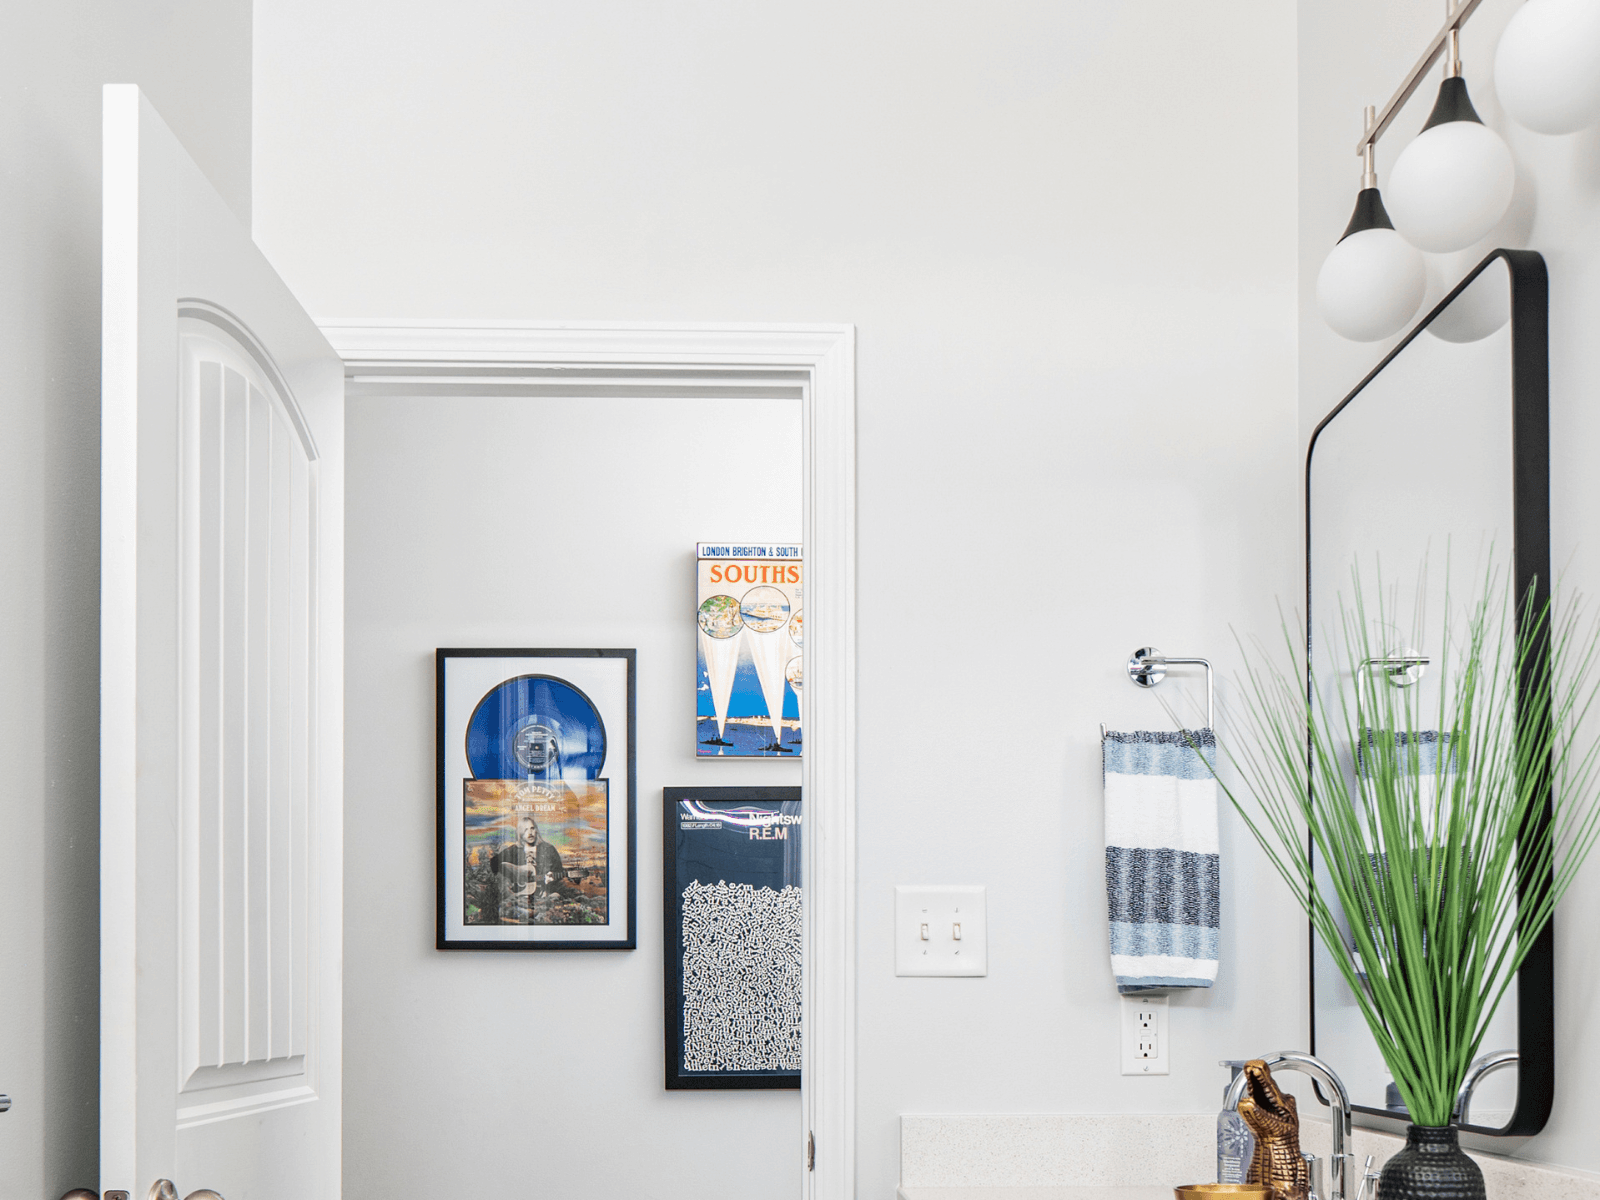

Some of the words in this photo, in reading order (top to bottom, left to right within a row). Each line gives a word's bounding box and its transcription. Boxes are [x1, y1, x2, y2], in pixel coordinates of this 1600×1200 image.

[702, 546, 730, 556] LONDON
[732, 546, 766, 556] BRIGHTON
[768, 546, 774, 556] &
[776, 546, 798, 557] SOUTH
[710, 564, 803, 584] SOUTHS
[516, 786, 531, 799] TOM
[531, 785, 555, 799] PETTY
[749, 827, 788, 840] R.E.M
